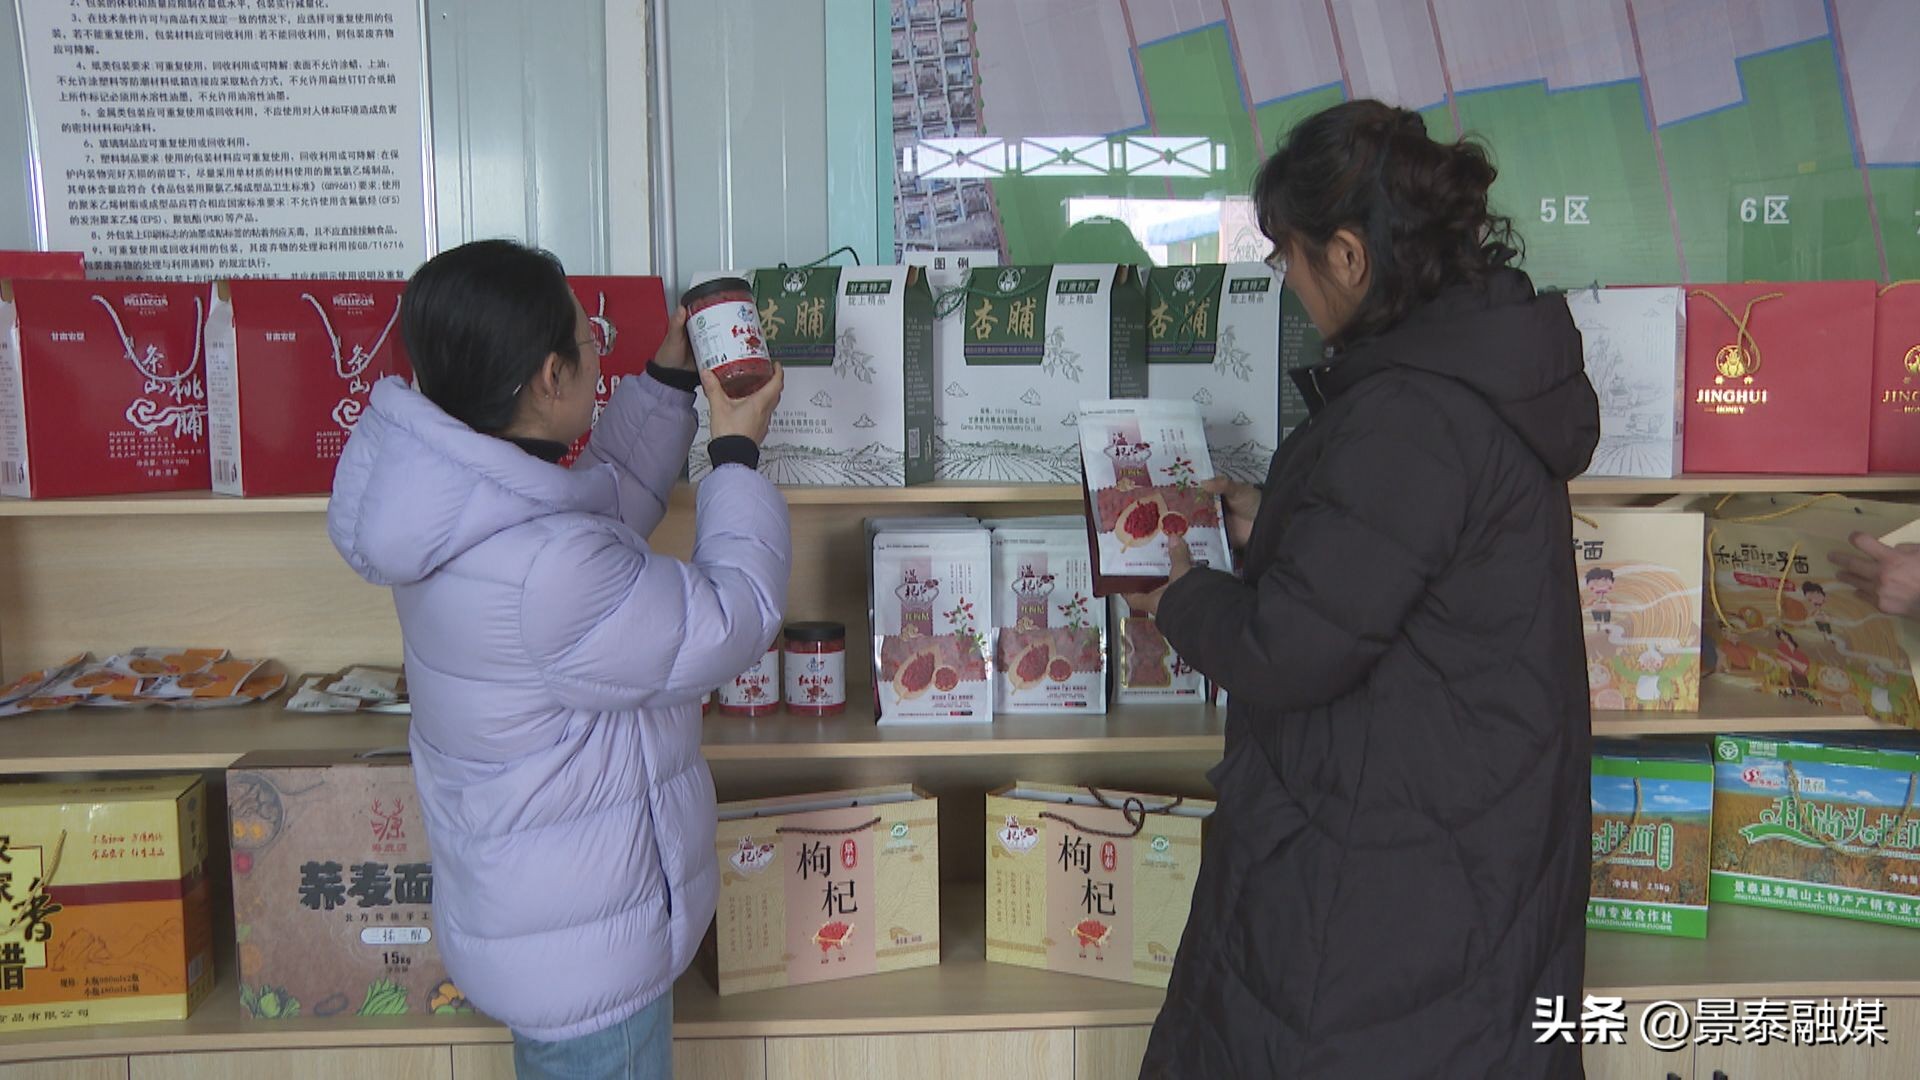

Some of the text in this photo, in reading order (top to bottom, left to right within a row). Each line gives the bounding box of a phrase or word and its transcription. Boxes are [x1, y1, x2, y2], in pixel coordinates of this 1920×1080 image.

[1540, 195, 1590, 225] 5区
[1740, 195, 1790, 225] 6区
[759, 298, 826, 341] 杏脯
[970, 297, 1037, 340] 杏脯
[1696, 389, 1768, 404] JINGHUI
